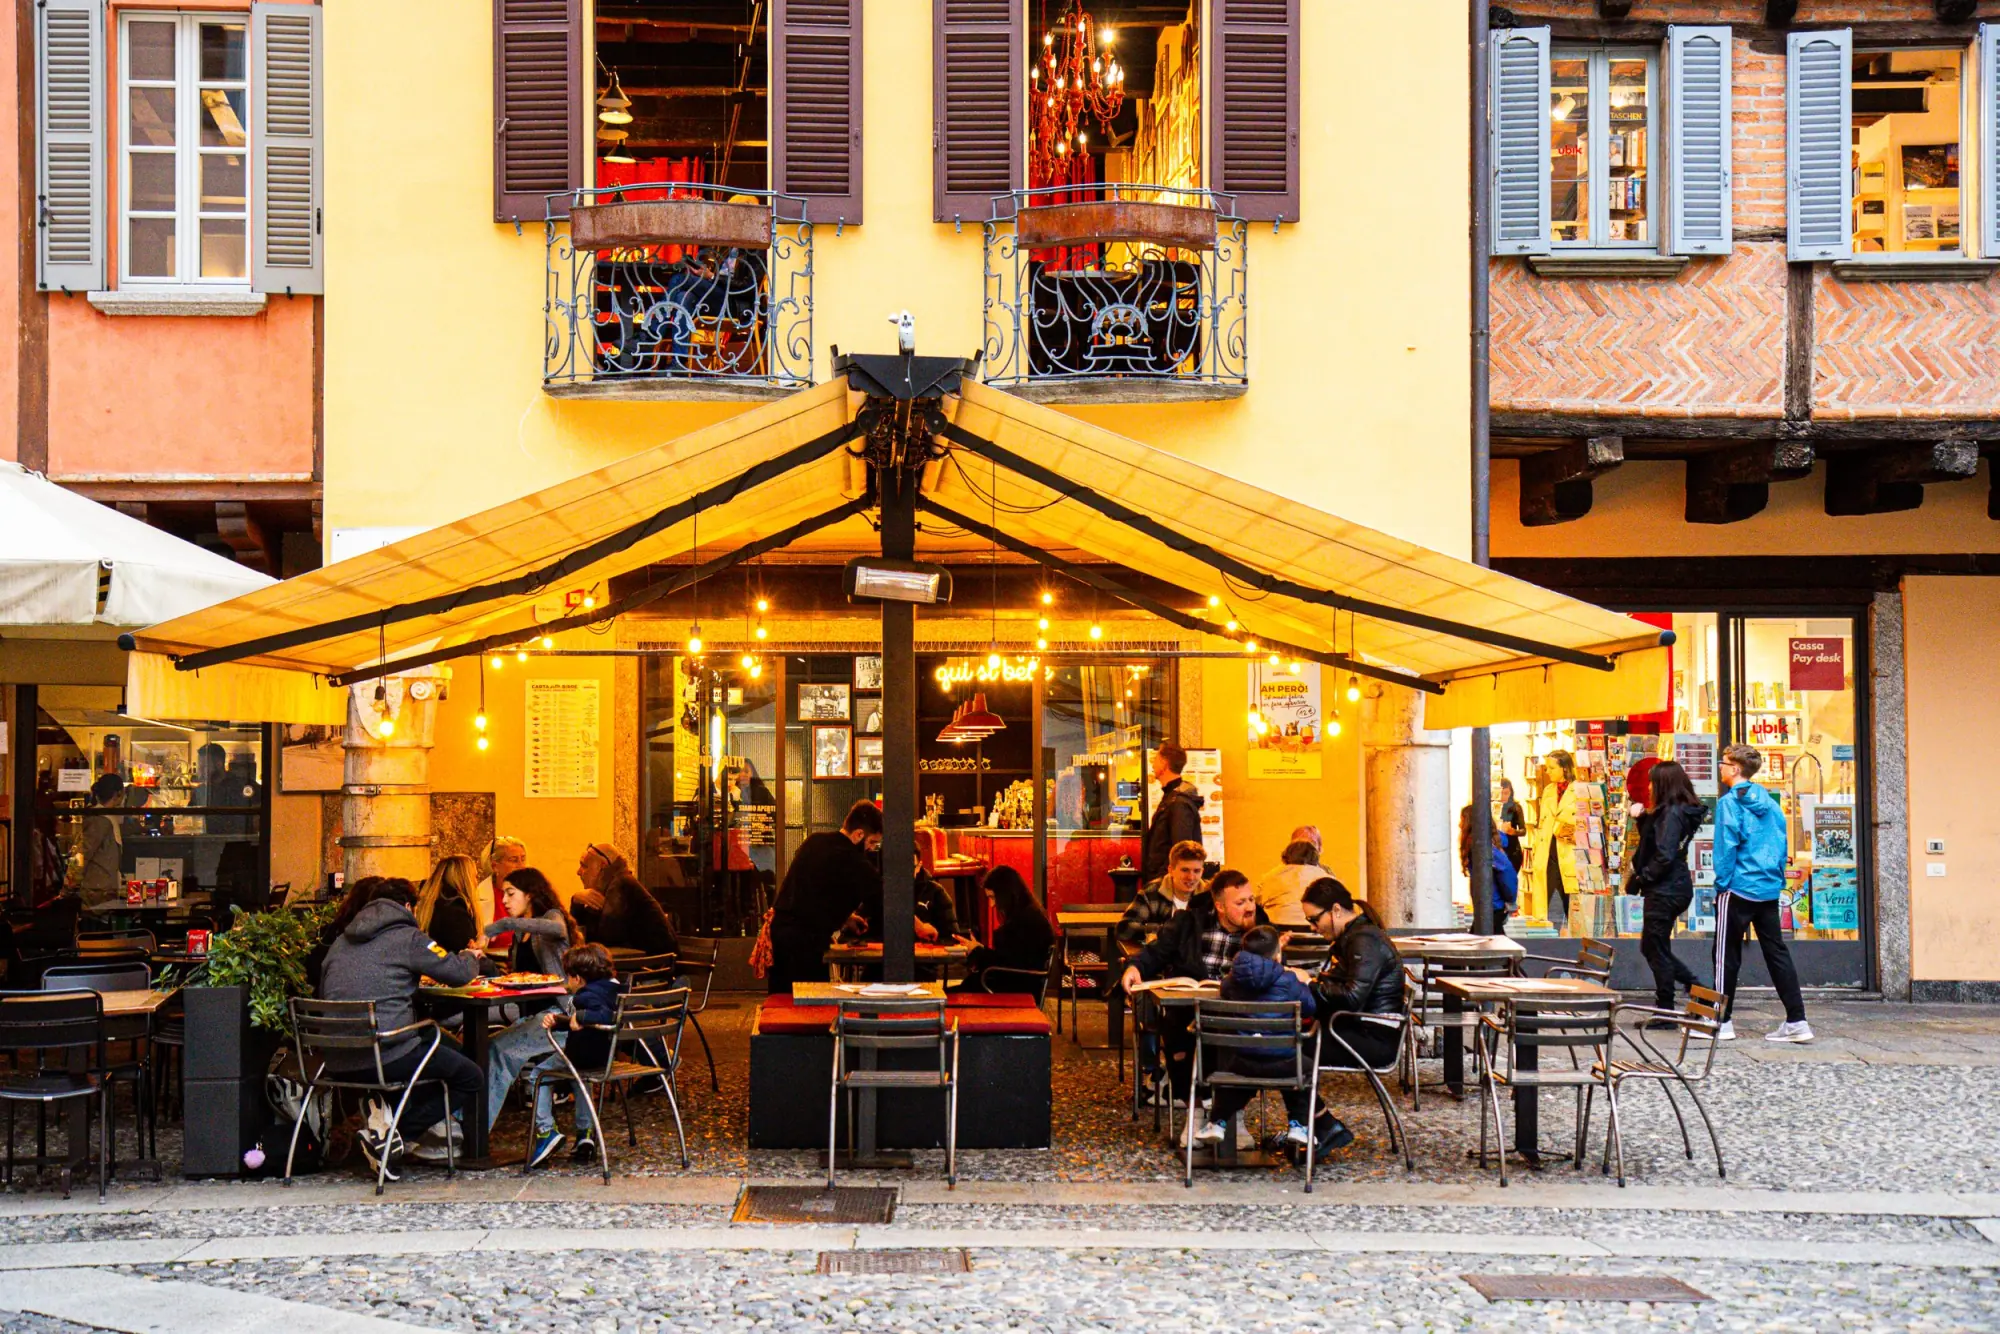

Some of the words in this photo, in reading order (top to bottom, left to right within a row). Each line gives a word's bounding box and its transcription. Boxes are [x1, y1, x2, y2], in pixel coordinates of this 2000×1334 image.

[1792, 641, 1824, 650] Cassa
[1792, 653, 1814, 665] Pay
[1815, 653, 1841, 663] desk
[936, 662, 973, 692] qui
[1261, 685, 1275, 693] AH
[1752, 718, 1788, 738] ubik
[1072, 754, 1108, 766] DOPPIO
[1824, 892, 1855, 905] Venti
